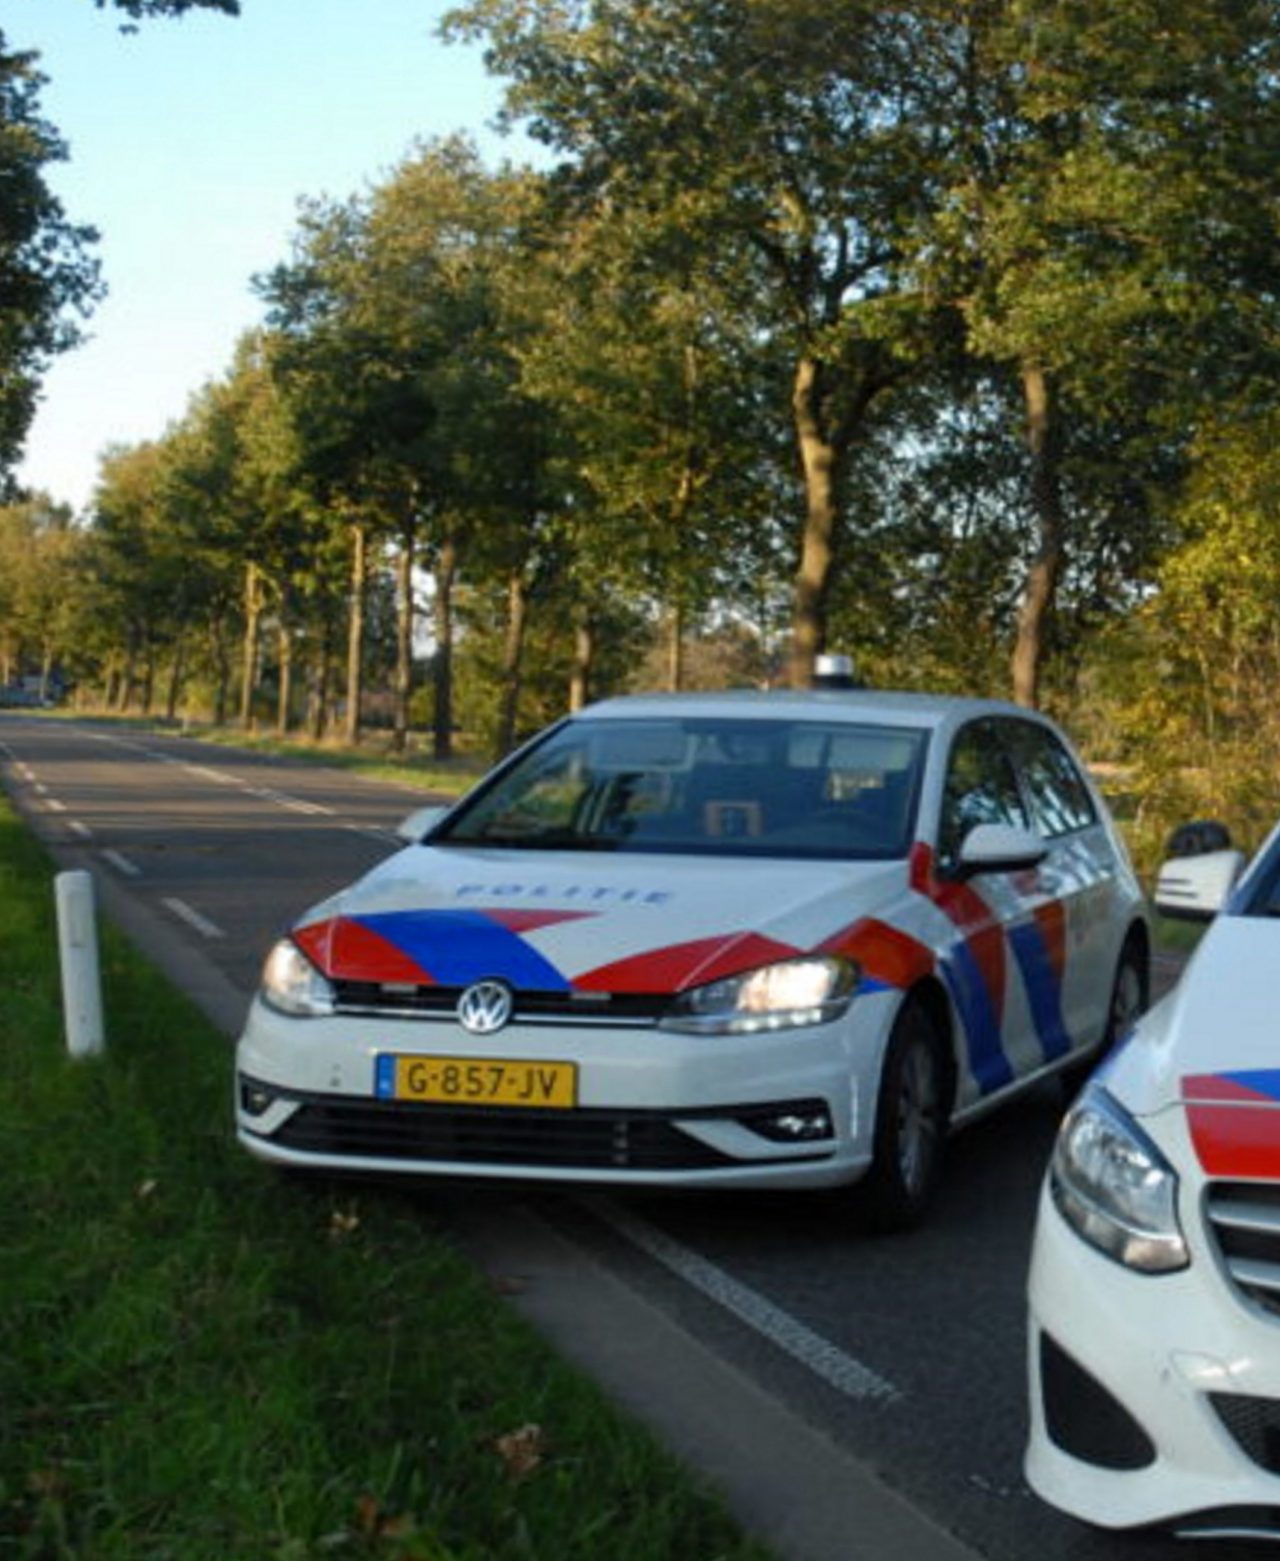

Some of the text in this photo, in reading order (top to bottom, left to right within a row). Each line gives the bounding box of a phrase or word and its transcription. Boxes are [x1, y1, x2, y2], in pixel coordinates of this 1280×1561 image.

[456, 883, 675, 904] POLITIE
[460, 982, 510, 1032] VW
[407, 1062, 557, 1098] G-857-JV
